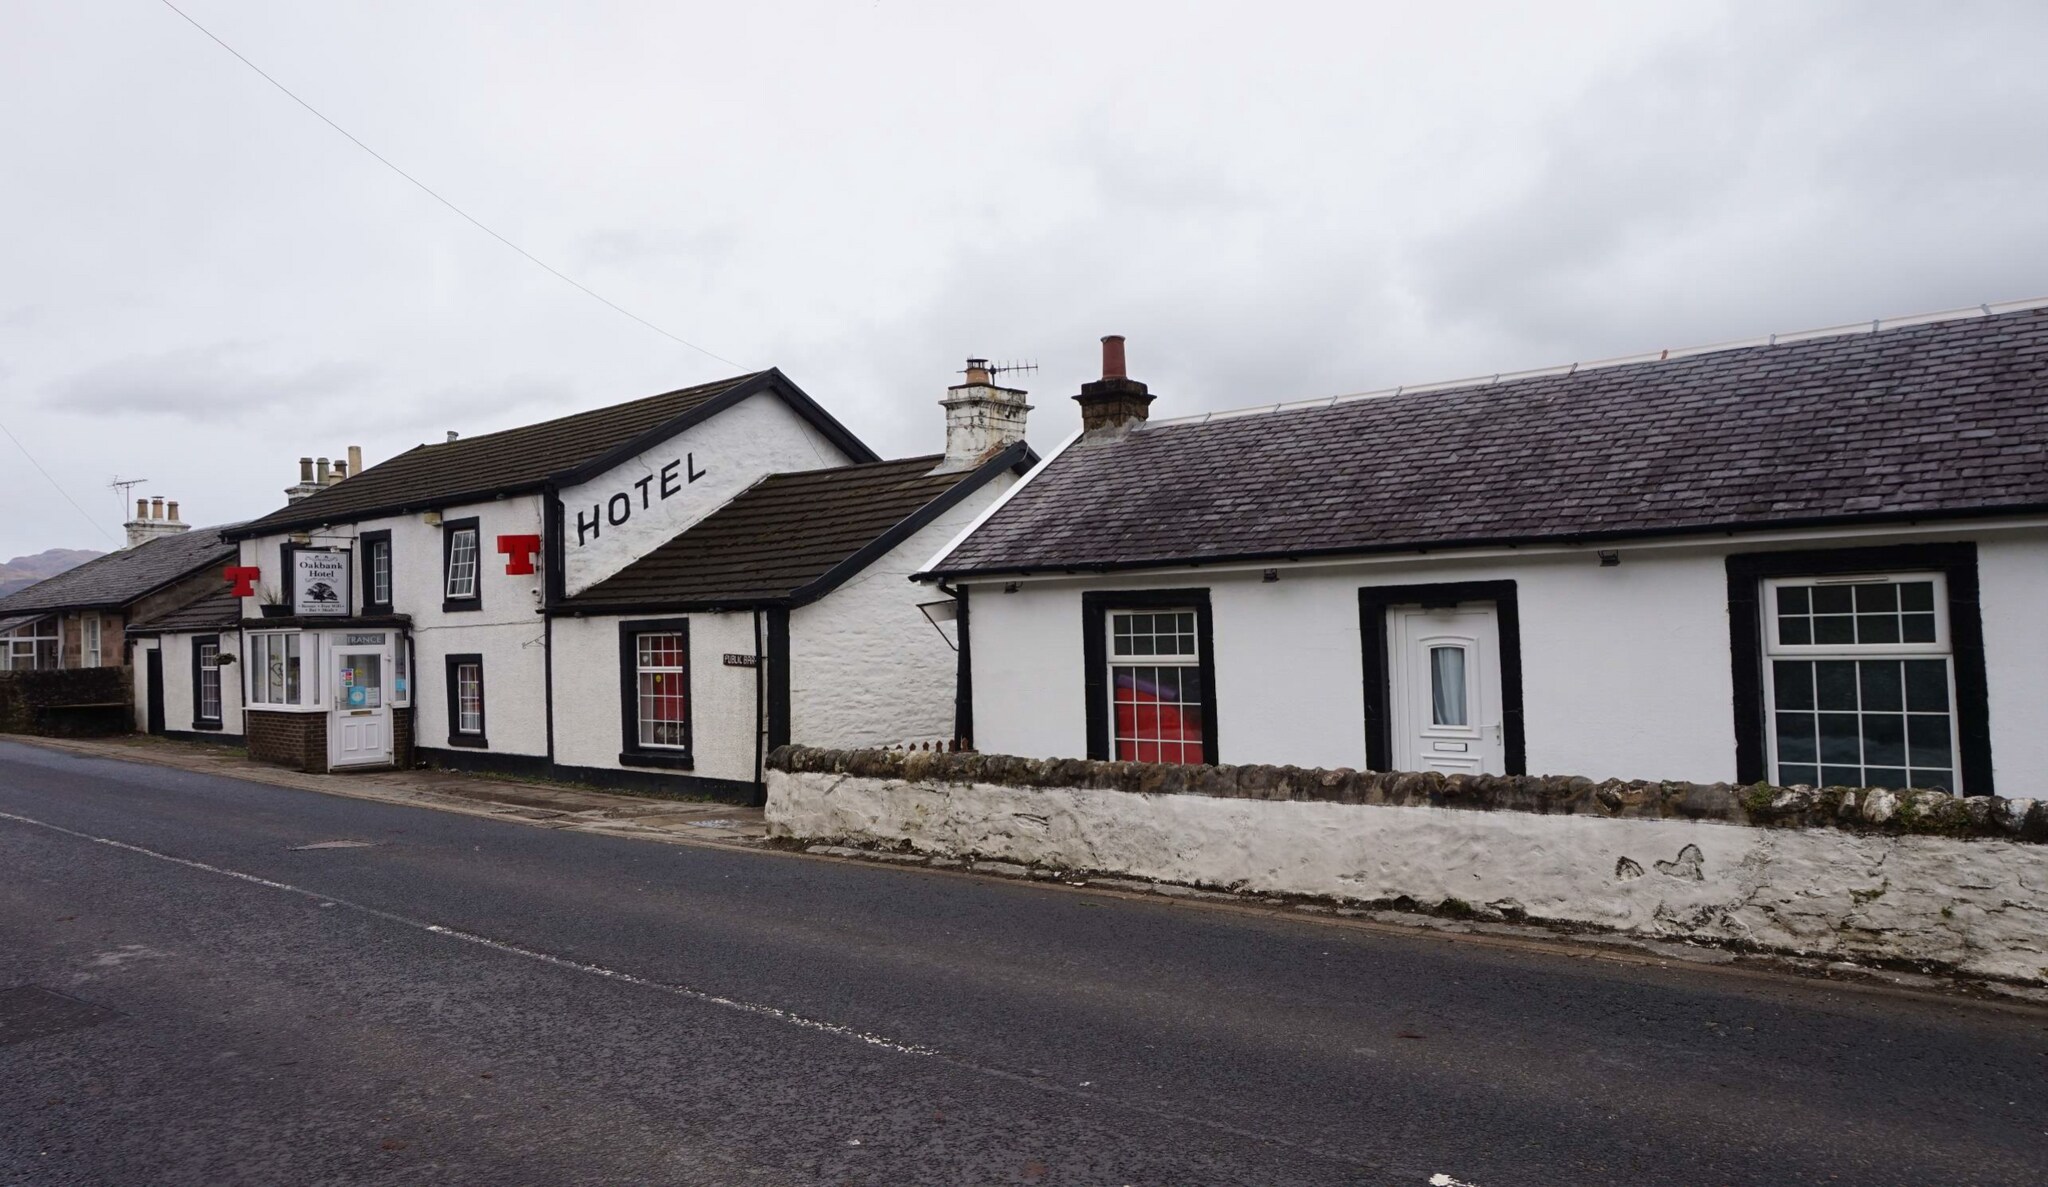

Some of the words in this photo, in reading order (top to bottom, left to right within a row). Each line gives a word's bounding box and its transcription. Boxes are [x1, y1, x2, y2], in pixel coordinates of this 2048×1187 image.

[577, 452, 706, 547] HOTEL
[497, 534, 541, 575] T
[225, 567, 260, 597] T
[724, 654, 743, 664] PUBLIC
